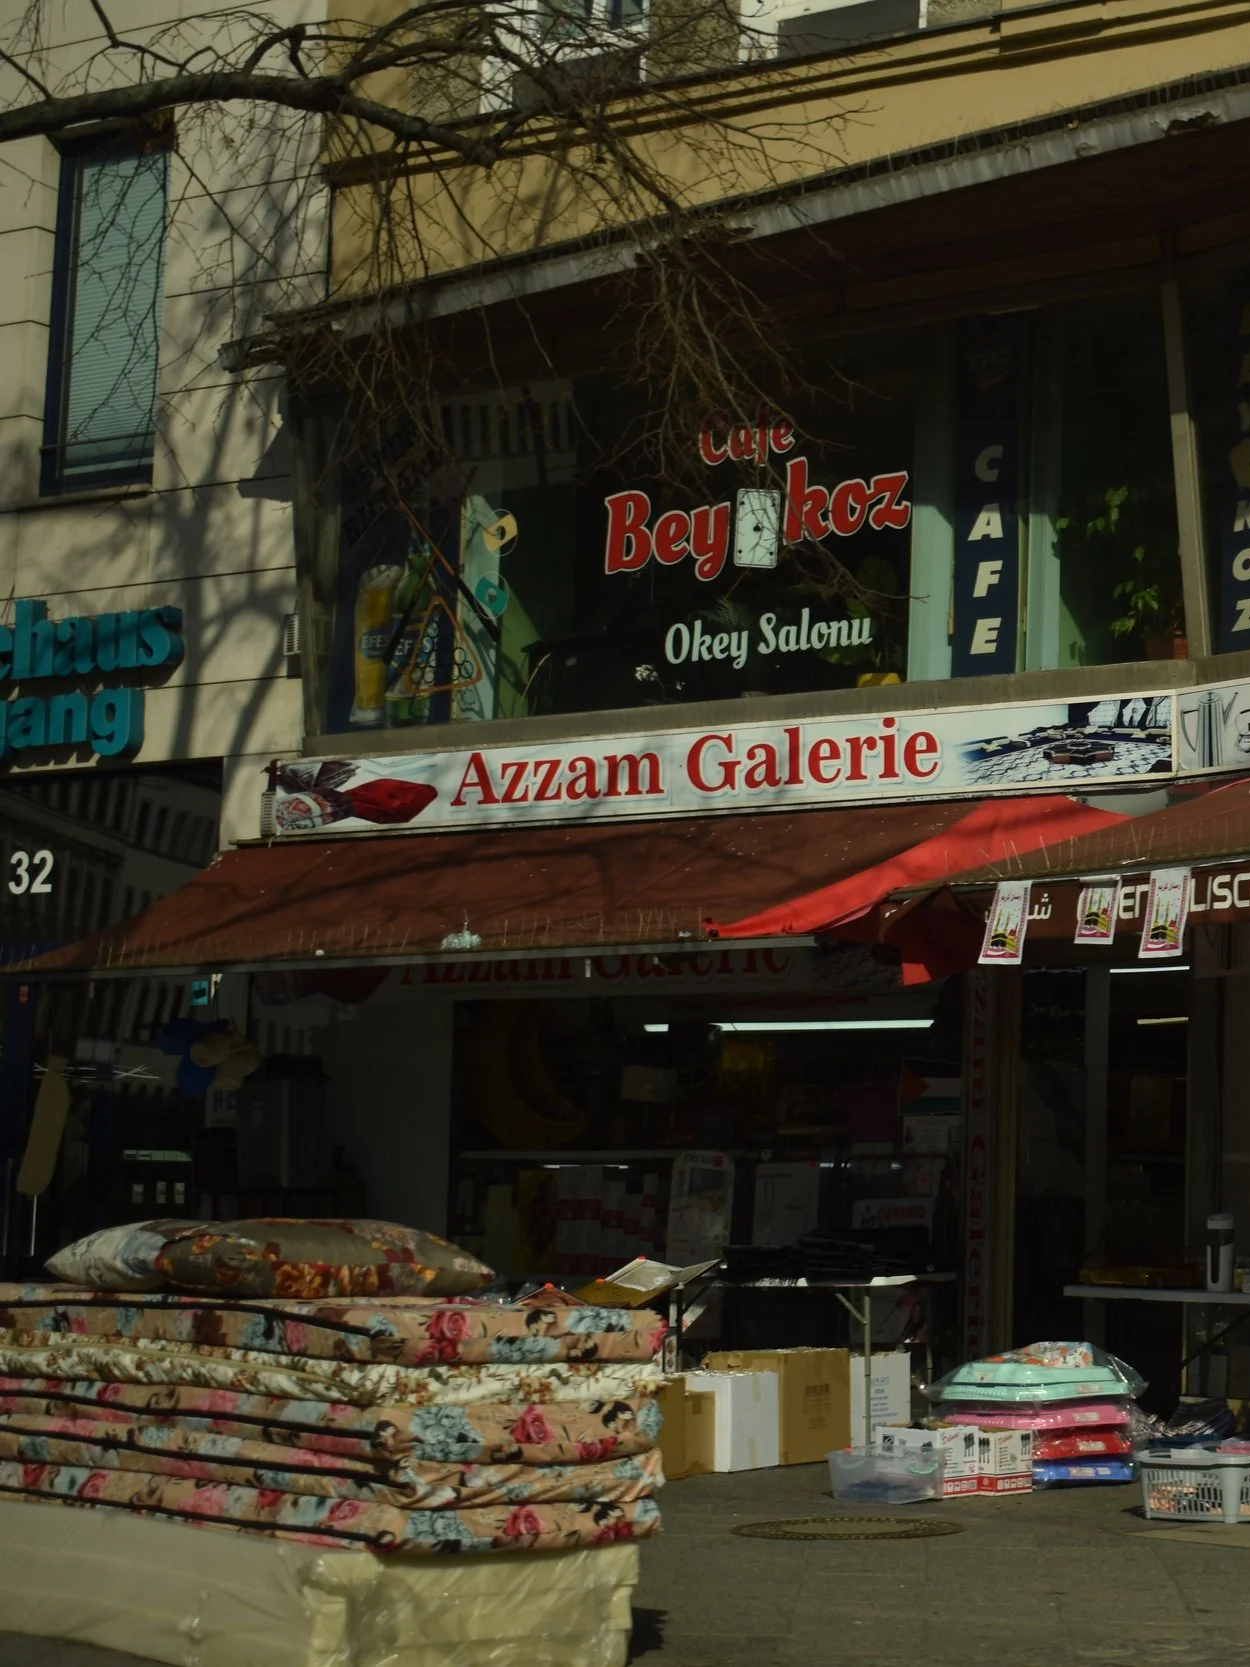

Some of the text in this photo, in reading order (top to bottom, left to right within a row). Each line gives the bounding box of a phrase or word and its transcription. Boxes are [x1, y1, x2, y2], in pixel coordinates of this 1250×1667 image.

[699, 408, 796, 467] Cafe
[967, 444, 1004, 655] CAFE
[664, 607, 873, 671] Okey Salonu
[0, 686, 144, 758] ang
[449, 717, 940, 807] Azzam Galerie
[8, 849, 55, 896] 32
